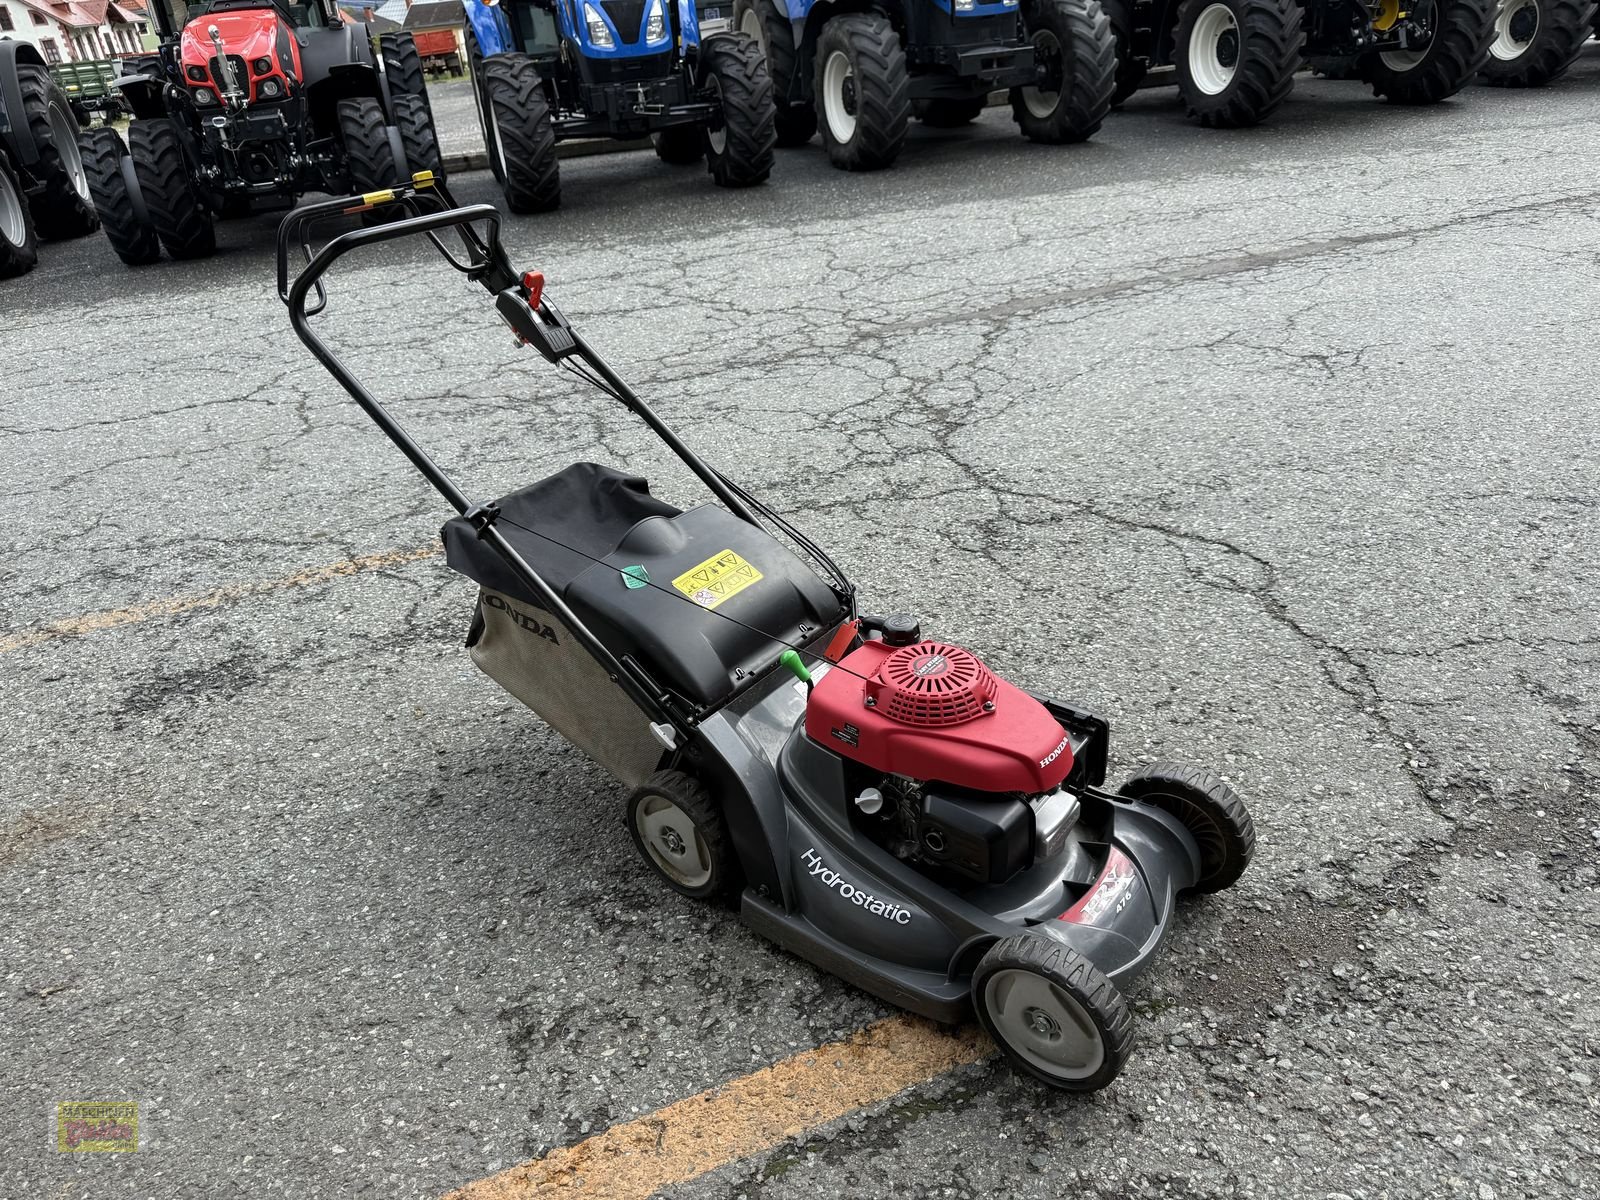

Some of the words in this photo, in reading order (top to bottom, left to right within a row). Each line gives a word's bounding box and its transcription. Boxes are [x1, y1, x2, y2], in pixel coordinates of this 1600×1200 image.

[1039, 736, 1068, 769] HONDA
[800, 848, 911, 925] Hydrostatic
[1080, 863, 1136, 922] HRX
[1116, 890, 1132, 914] 476
